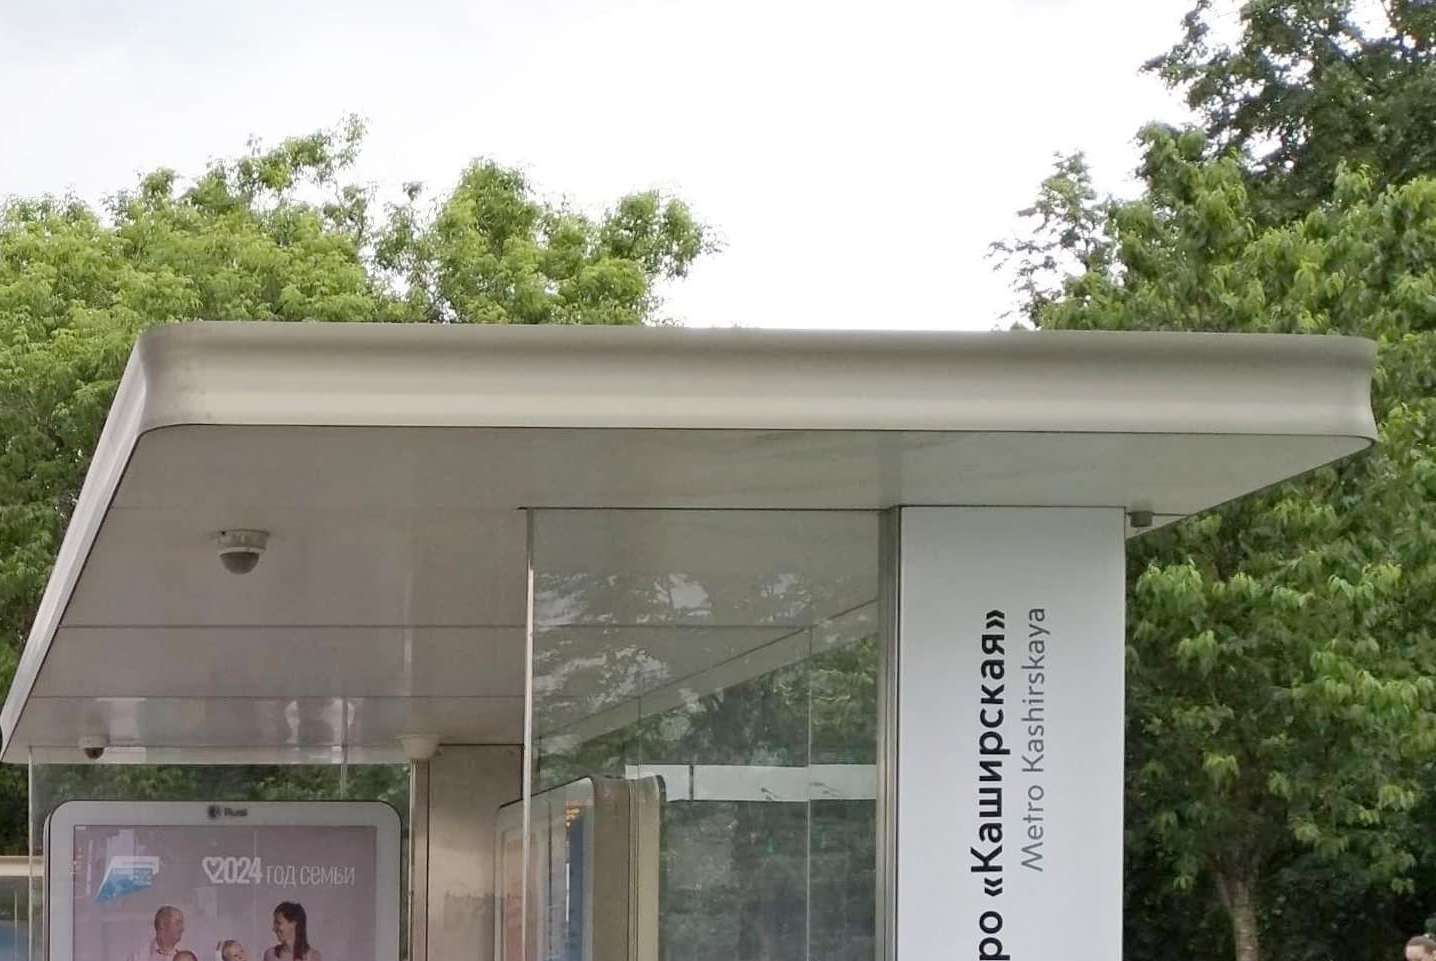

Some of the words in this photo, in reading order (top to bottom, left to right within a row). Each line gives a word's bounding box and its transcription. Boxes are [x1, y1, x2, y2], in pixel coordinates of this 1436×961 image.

[1021, 607, 1051, 772] Kashirskaya
[970, 609, 1011, 897] «Каширская»
[211, 856, 262, 884] 2024
[1021, 785, 1044, 872] Metro
